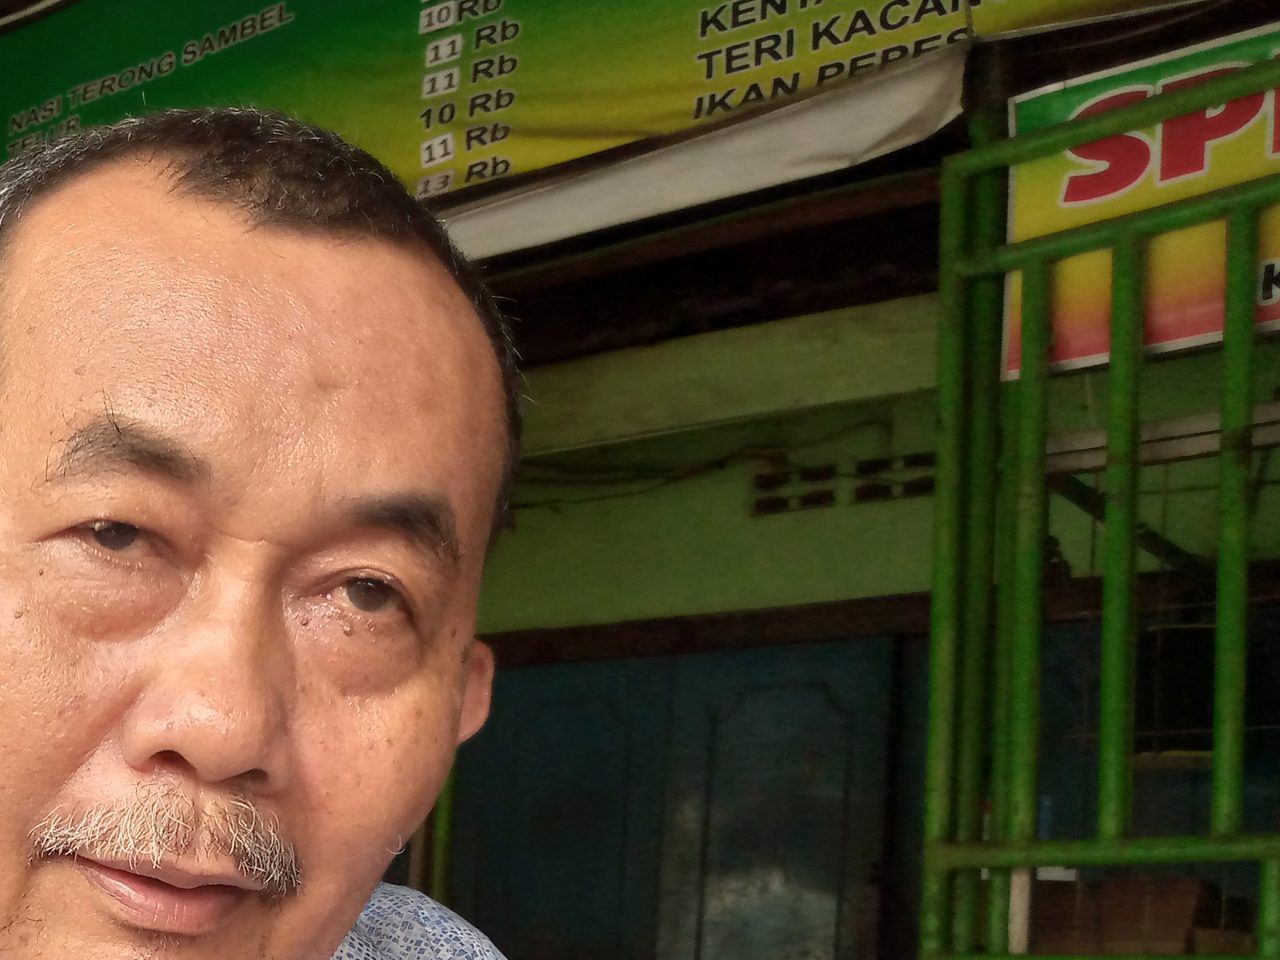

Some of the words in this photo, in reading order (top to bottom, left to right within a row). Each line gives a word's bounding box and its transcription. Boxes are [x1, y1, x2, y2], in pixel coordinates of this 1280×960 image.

[423, 6, 451, 28] 10
[430, 40, 459, 63] 11
[475, 20, 519, 49] Rb
[697, 29, 795, 79] TERI
[9, 96, 62, 133] NASI
[68, 53, 174, 107] TERONG
[183, 4, 293, 64] SAMBEL
[426, 72, 455, 95] 11
[472, 55, 517, 83] Rb
[420, 103, 455, 128] 10
[469, 89, 514, 117] Rb
[694, 72, 800, 118] IKAN
[425, 139, 453, 164] 11
[466, 123, 510, 150] Rb
[465, 156, 510, 183] Rb
